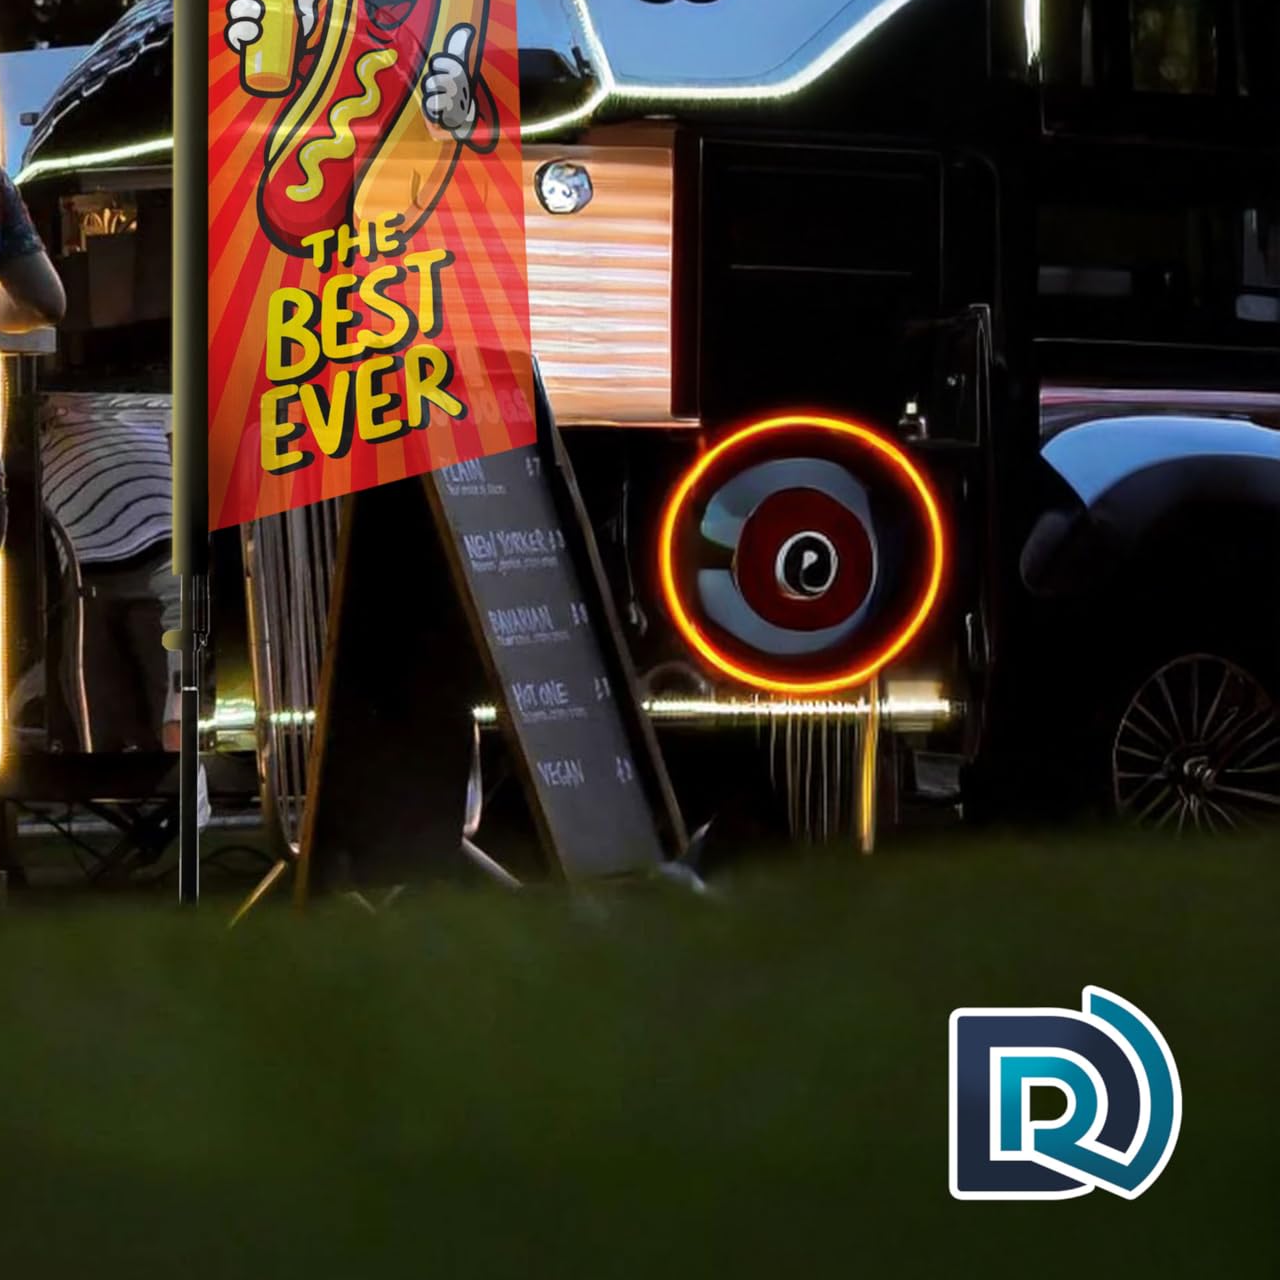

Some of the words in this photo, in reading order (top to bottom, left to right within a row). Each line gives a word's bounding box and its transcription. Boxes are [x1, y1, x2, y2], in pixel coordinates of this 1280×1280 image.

[301, 211, 404, 271] THE
[266, 248, 455, 384] BEST
[261, 344, 467, 475] EVER
[539, 680, 569, 706] ONE
[536, 759, 585, 789] VEGAN
